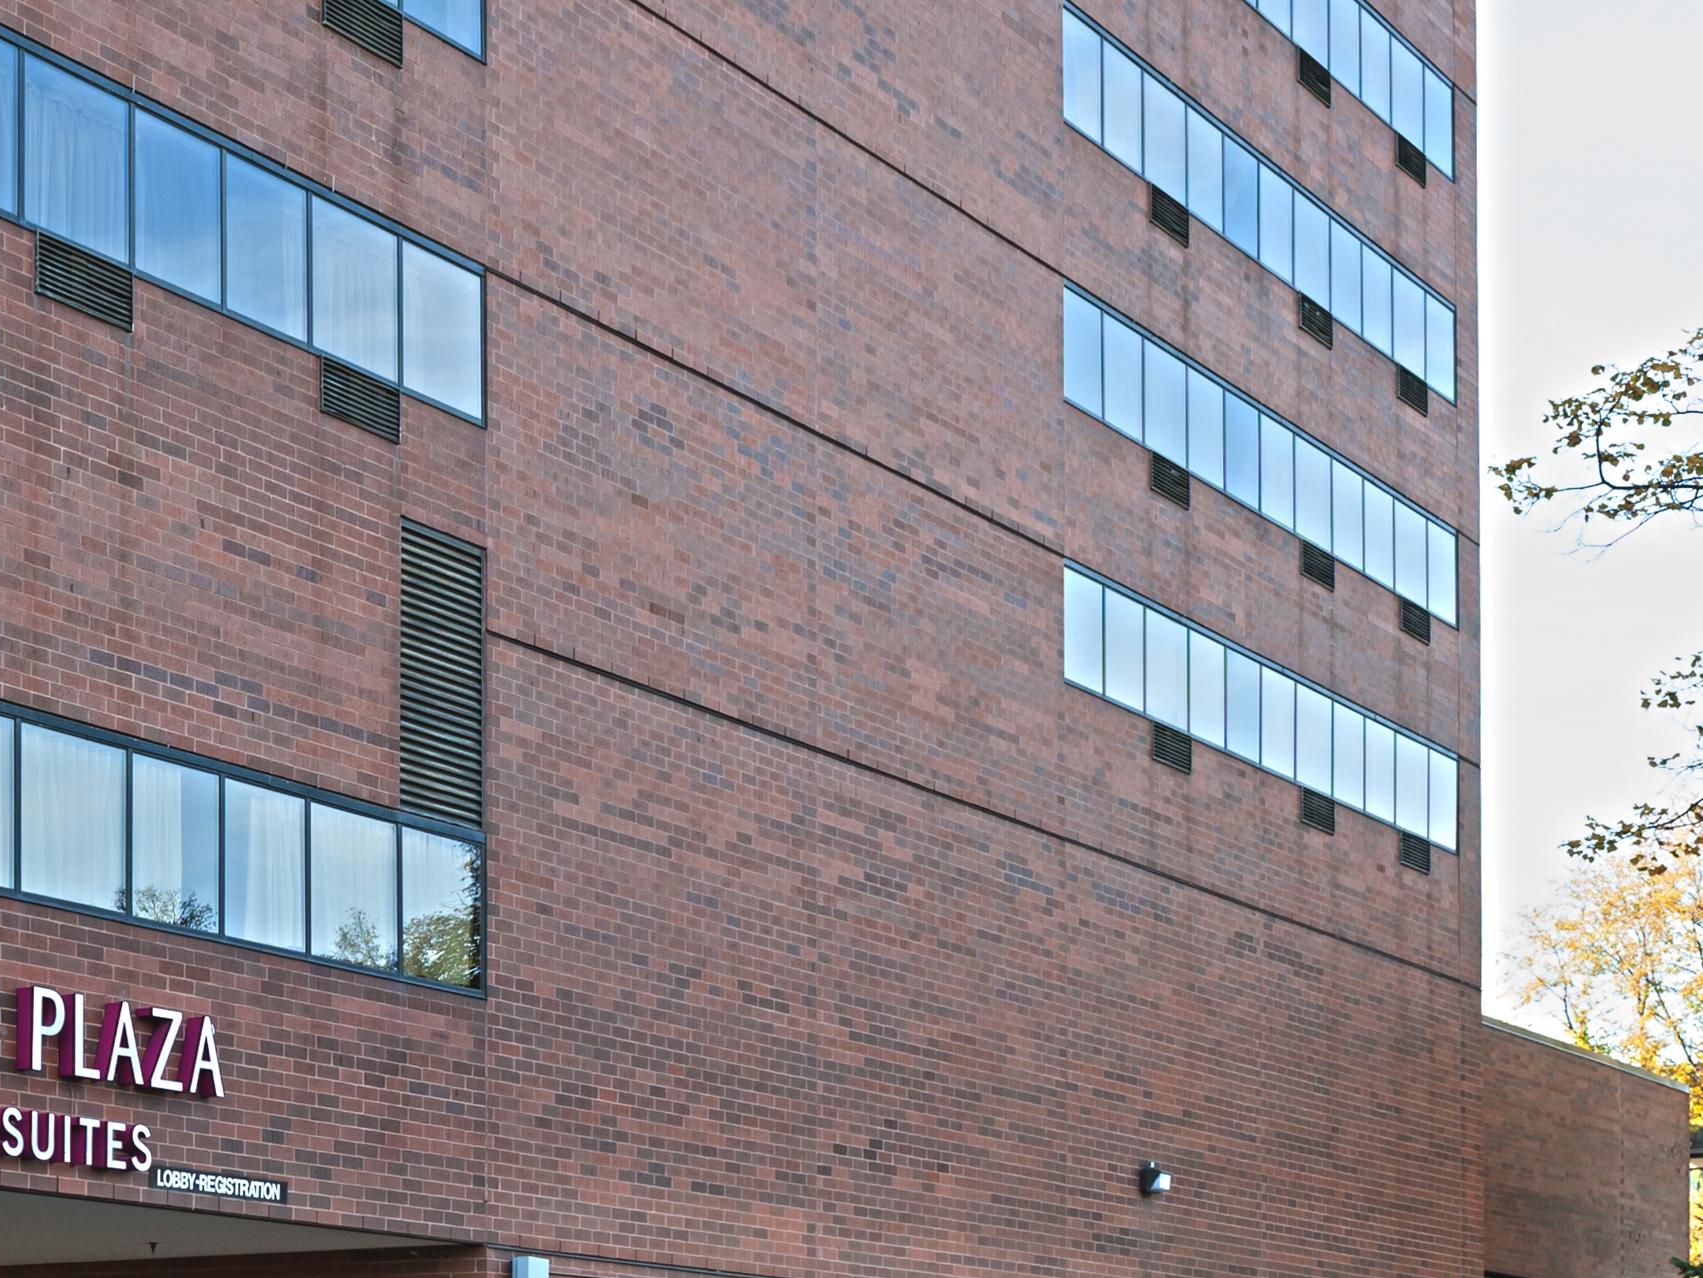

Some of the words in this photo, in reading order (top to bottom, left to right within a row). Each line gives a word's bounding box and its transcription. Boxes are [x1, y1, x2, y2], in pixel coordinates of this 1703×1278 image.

[29, 985, 226, 1098] PLAZA
[1, 1106, 153, 1173] SUITES
[156, 1168, 281, 1201] LOBBY-REGISTRATION
